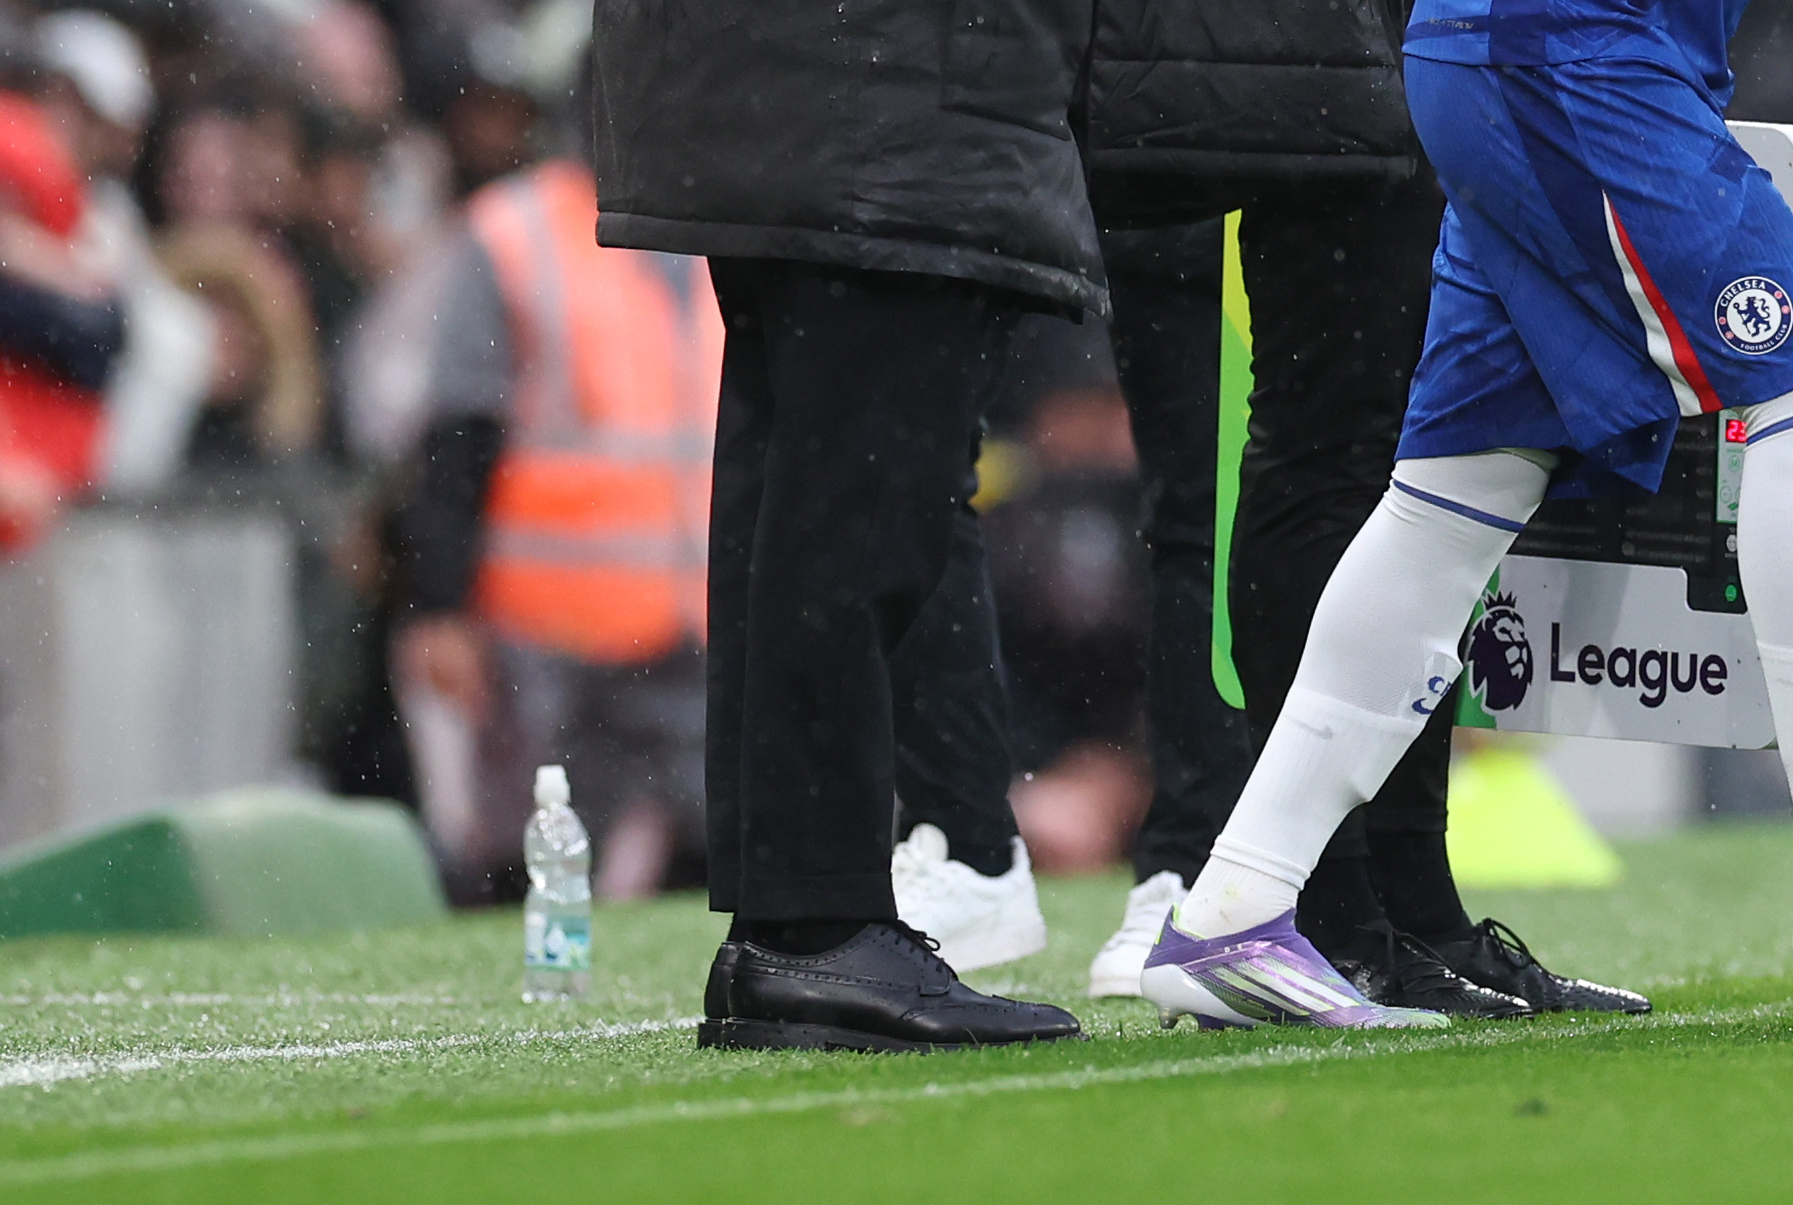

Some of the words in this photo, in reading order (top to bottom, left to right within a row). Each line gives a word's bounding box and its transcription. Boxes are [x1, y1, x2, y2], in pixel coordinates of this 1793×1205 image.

[1720, 280, 1766, 307] CHELSEA
[1740, 340, 1775, 351] FOOTBALL
[1775, 324, 1788, 341] CLUB
[1550, 622, 1728, 708] League
